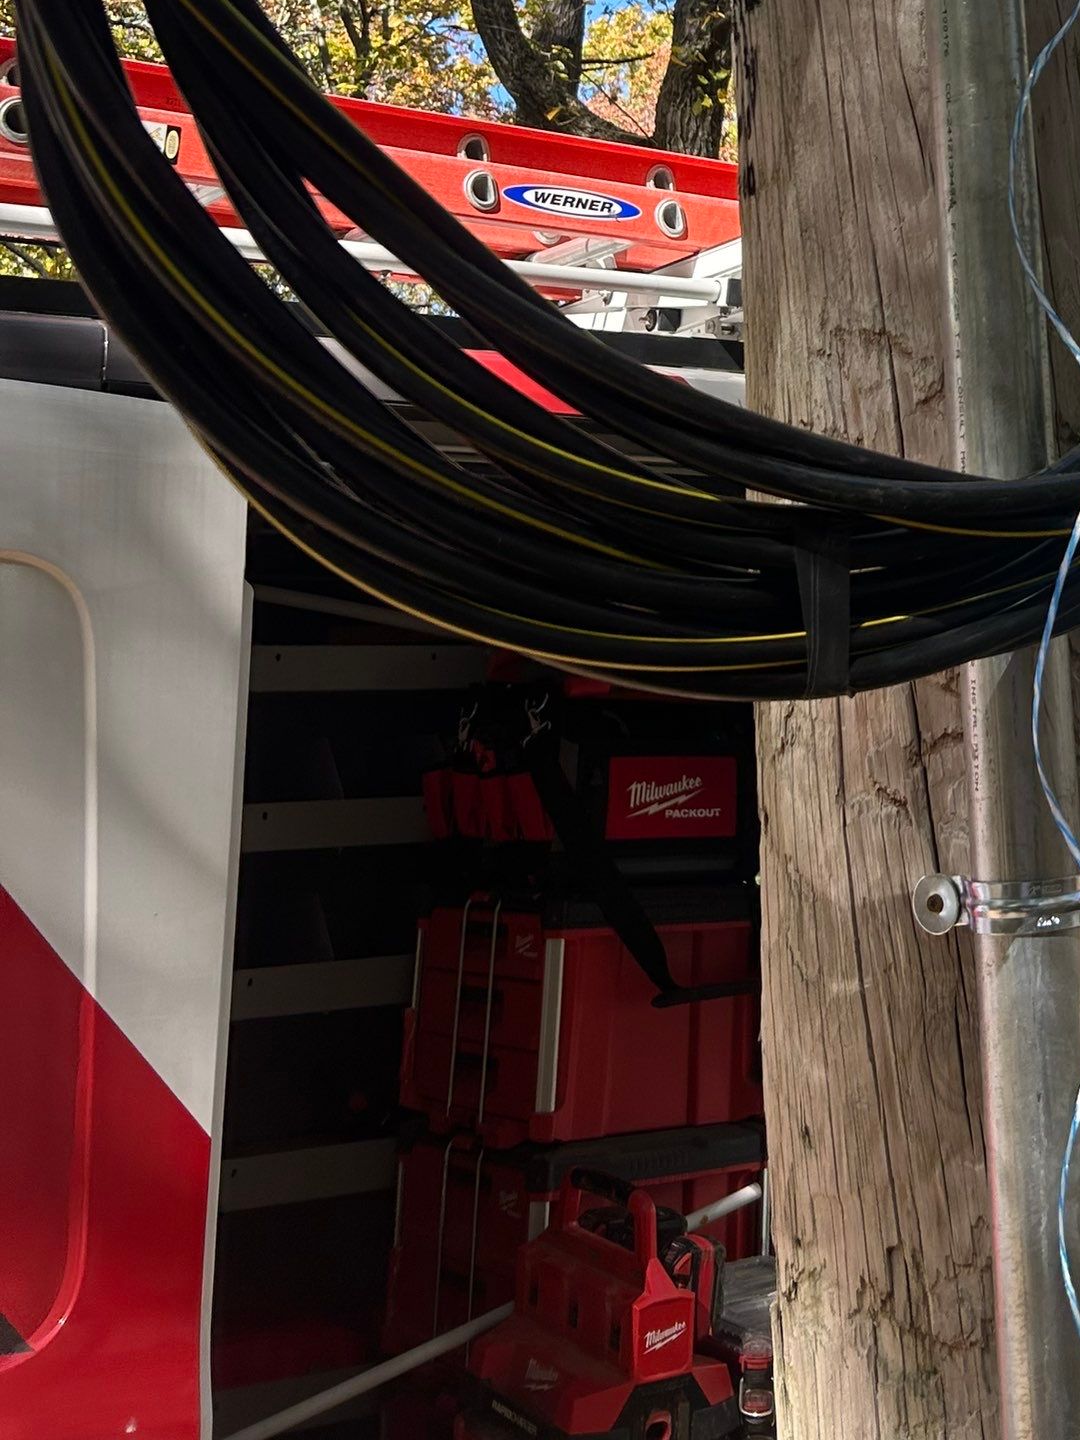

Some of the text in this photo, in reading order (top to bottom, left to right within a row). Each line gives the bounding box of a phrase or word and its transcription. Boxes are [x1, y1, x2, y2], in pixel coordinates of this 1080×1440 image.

[533, 190, 615, 214] WERNER
[626, 773, 703, 808] Milwaukee
[665, 807, 721, 818] PACKOUT
[643, 1320, 687, 1349] Milwaukee
